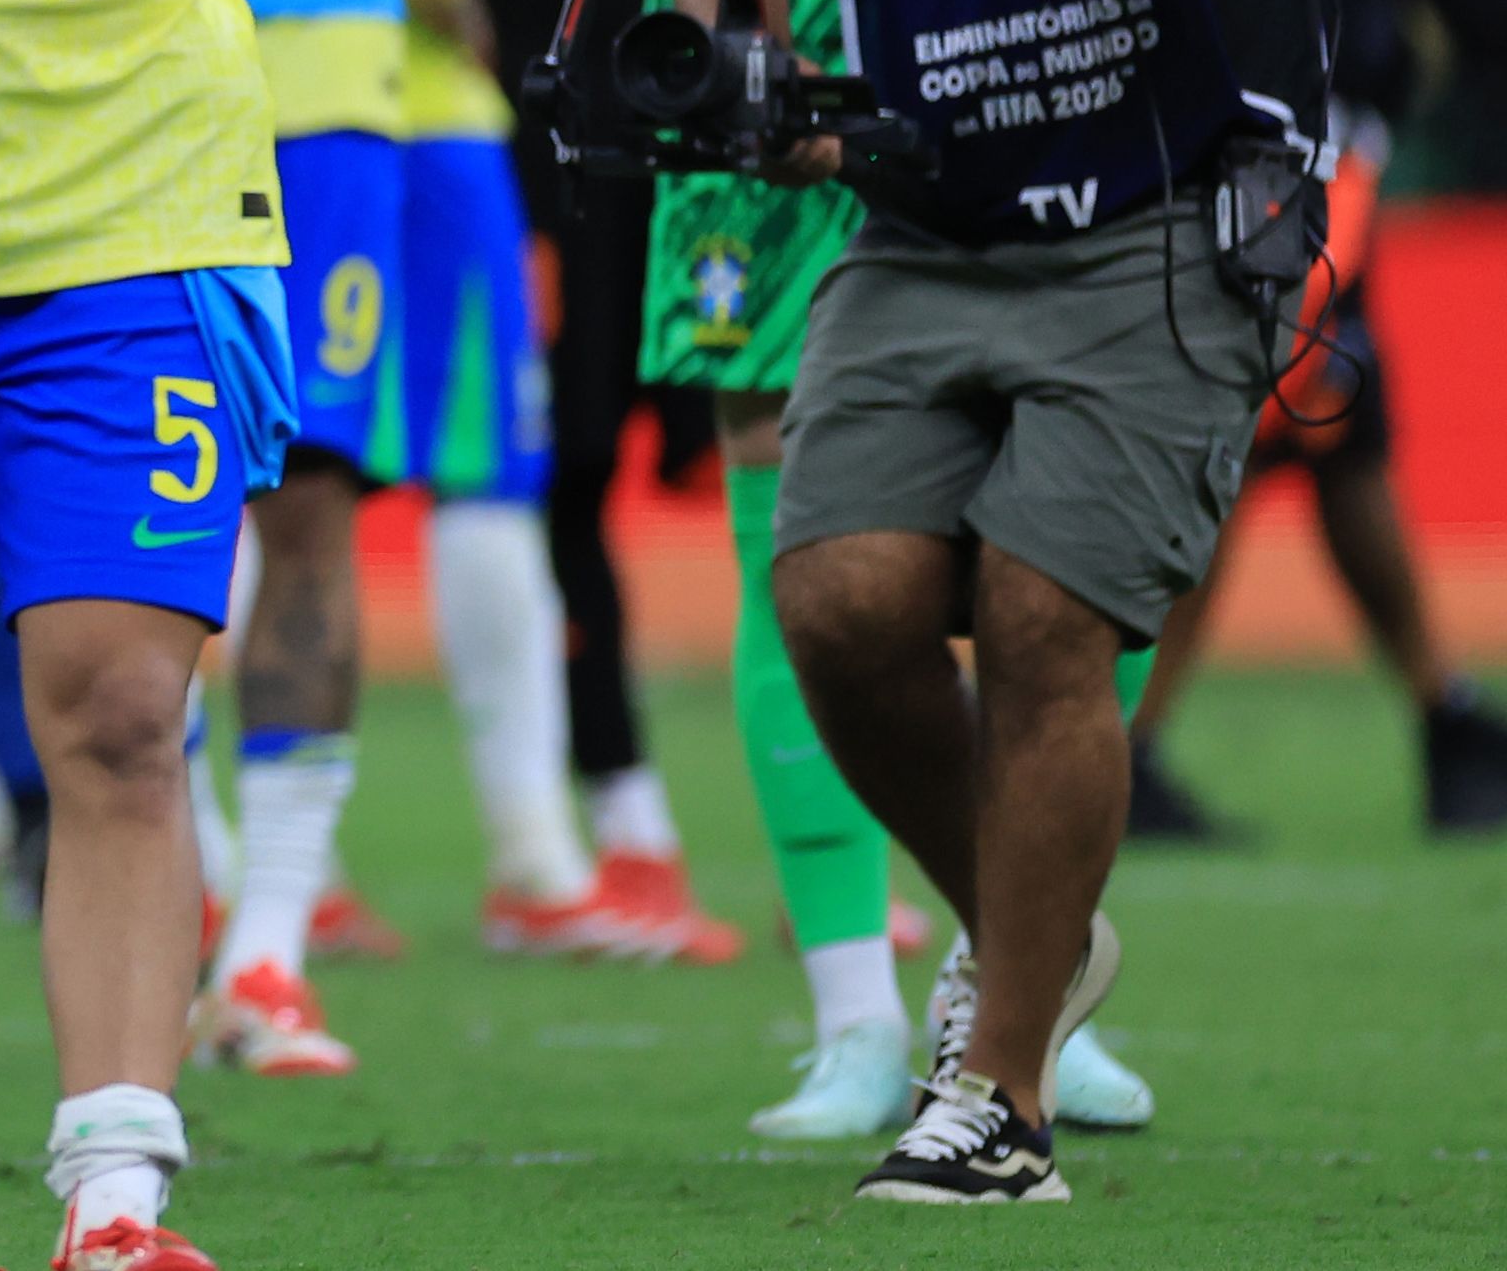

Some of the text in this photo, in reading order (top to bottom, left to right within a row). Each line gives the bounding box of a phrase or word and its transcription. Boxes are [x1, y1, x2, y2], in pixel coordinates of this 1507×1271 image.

[920, 55, 1010, 102] COPA
[1018, 177, 1098, 228] TV
[319, 254, 382, 376] 9
[149, 376, 218, 503] 5
